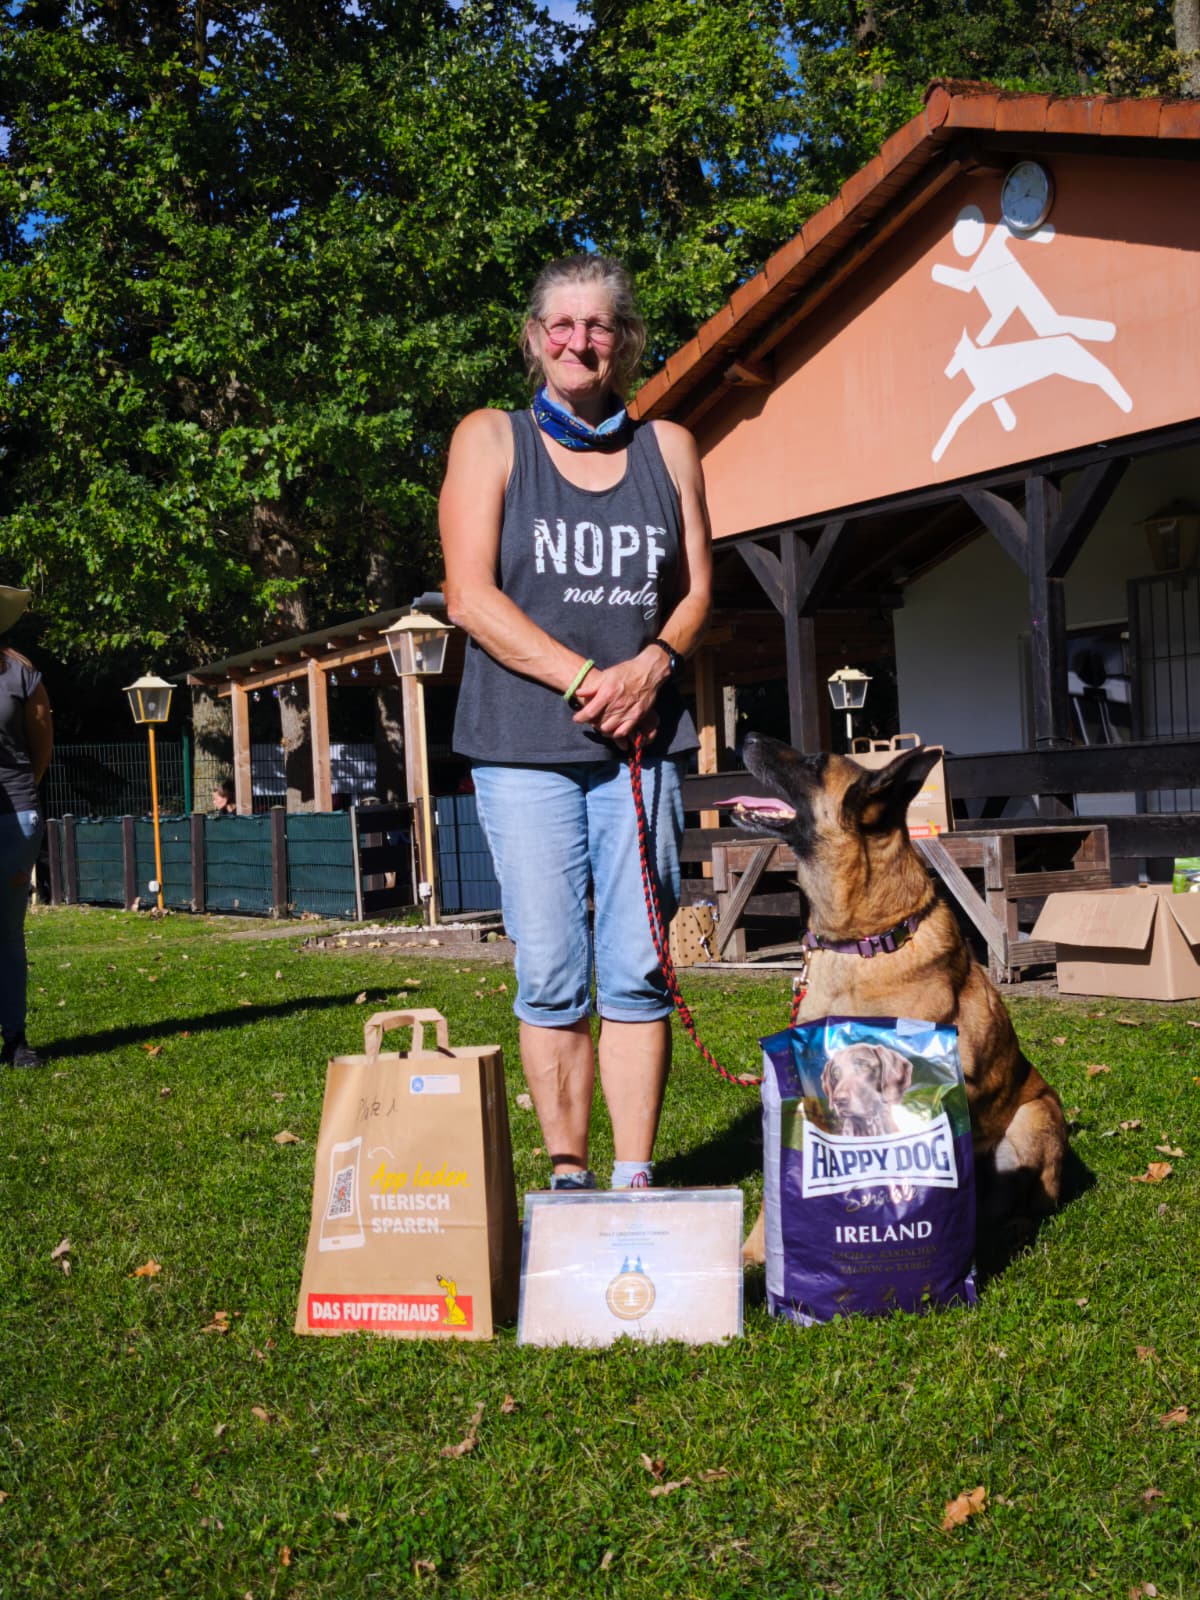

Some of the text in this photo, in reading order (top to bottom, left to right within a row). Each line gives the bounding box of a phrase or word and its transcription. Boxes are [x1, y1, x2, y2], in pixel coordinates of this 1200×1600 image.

[563, 586, 604, 605] not
[811, 1133, 951, 1180] HAPPY DOG
[369, 1160, 469, 1195] App laden
[369, 1193, 450, 1211] TIERISCH
[371, 1216, 446, 1234] SPAREN.
[835, 1220, 933, 1243] IRELAND
[624, 1287, 640, 1306] 1
[312, 1302, 439, 1322] DAS FUTTERHAUS
